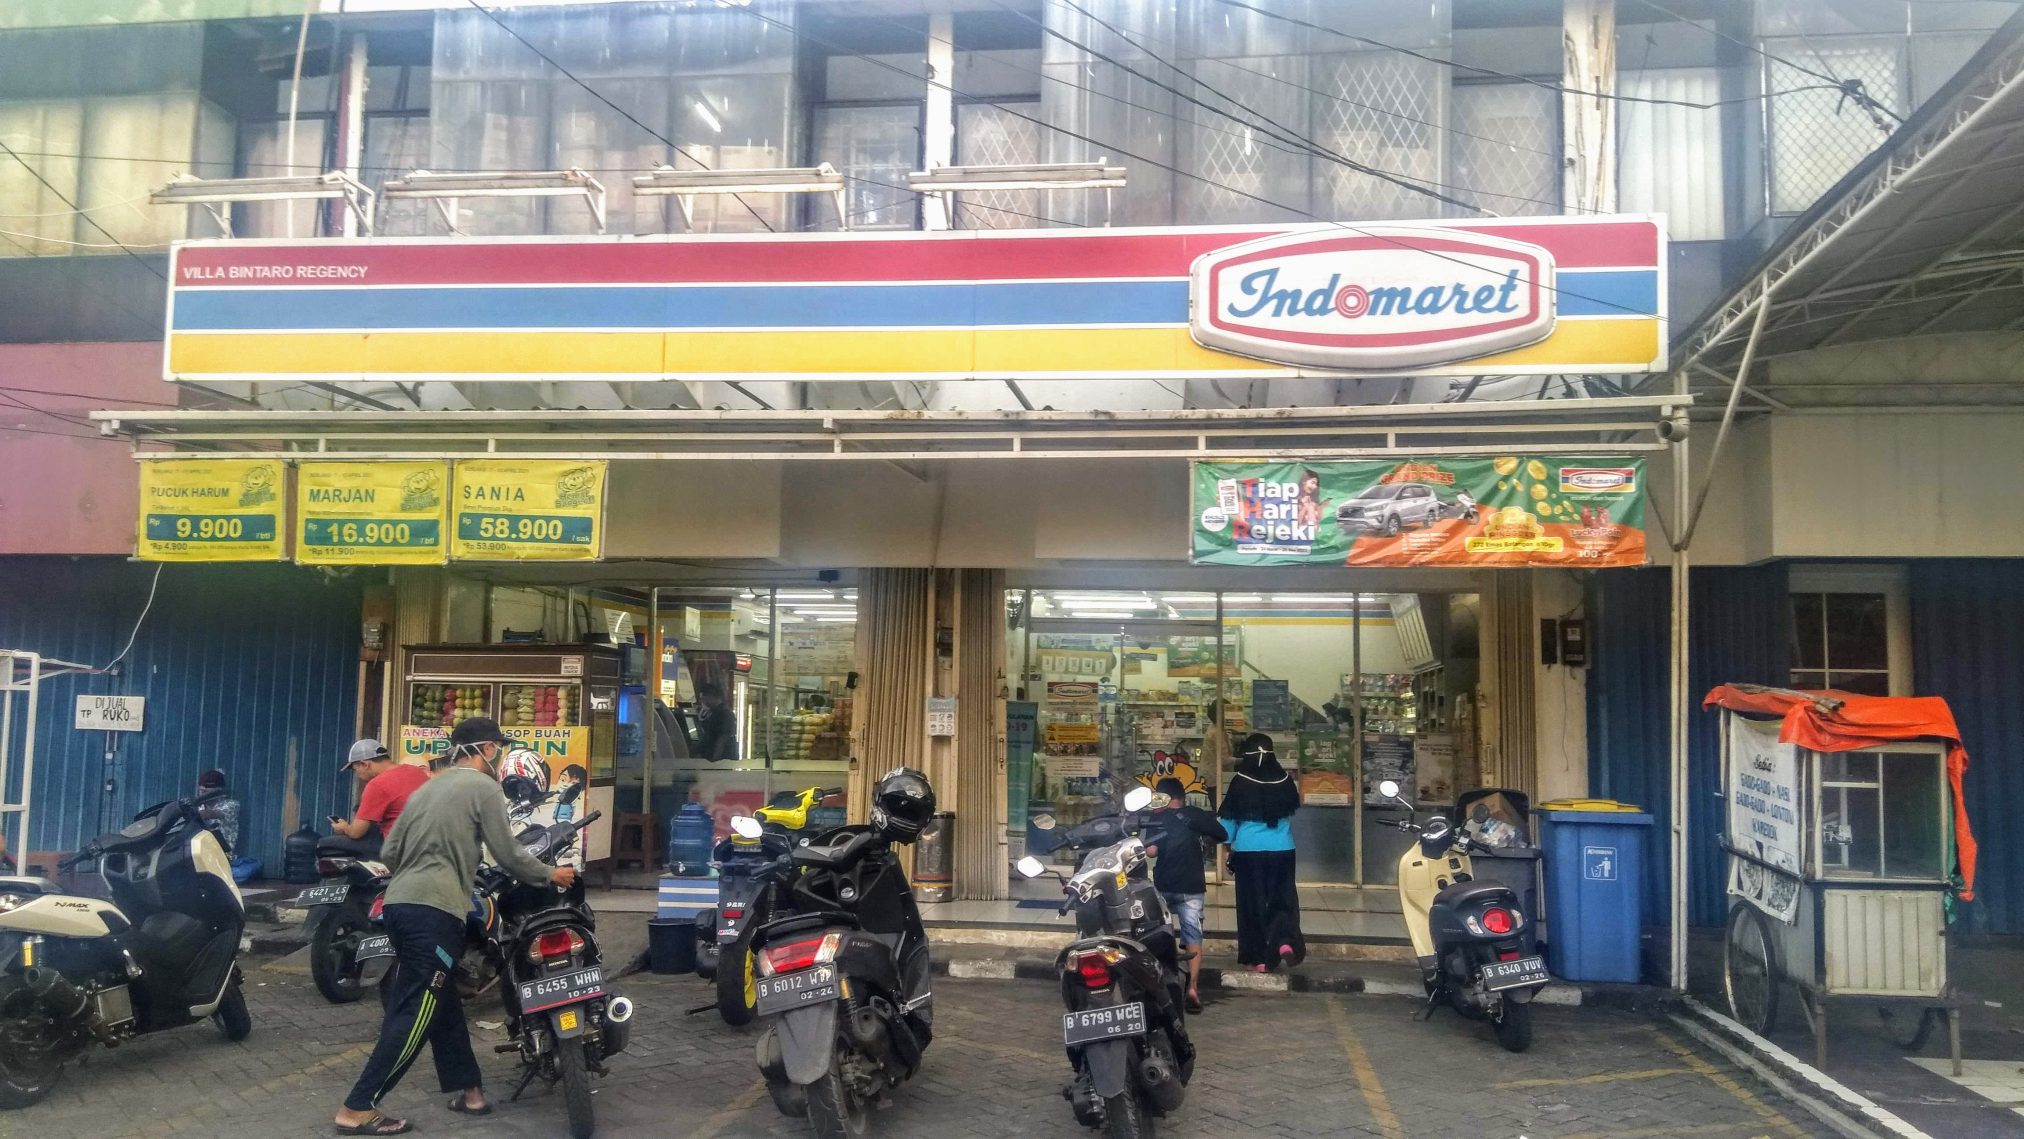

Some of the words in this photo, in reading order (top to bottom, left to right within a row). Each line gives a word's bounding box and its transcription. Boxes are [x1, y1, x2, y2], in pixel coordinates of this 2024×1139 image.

[184, 266, 226, 279] VILLA
[229, 265, 294, 279] BINTARO
[297, 264, 368, 279] REGENCY
[1227, 266, 1520, 319] Indomaret
[151, 486, 189, 498] PUCUK
[191, 487, 230, 498] HARUM
[309, 488, 376, 503] MARJAN
[1241, 477, 1300, 501] Tiap
[1244, 498, 1299, 520] Hari
[148, 518, 160, 526] Rp
[176, 517, 243, 539] 9.900
[307, 522, 318, 531] Rp
[327, 522, 410, 544] 16.900
[462, 517, 472, 525] Rp
[479, 517, 563, 540] 58.900
[1232, 520, 1315, 543] Rejeki
[164, 542, 188, 551] 4.900
[325, 547, 355, 555] 11.900
[476, 542, 507, 551] 53.900
[80, 709, 92, 718] TP
[102, 709, 130, 721] RUKO
[403, 728, 447, 737] ANEKA
[505, 729, 530, 738] SOP
[534, 729, 571, 738] BUAH
[1486, 968, 1494, 977] B
[1497, 964, 1521, 976] 6340
[1523, 960, 1541, 971] VUV
[524, 987, 532, 998] B
[537, 978, 568, 995] 6455
[574, 970, 600, 986] WHN
[760, 984, 768, 997] B
[774, 976, 803, 993] 6012
[1066, 1016, 1074, 1029] B
[1081, 1010, 1112, 1026] 6799
[1115, 1005, 1141, 1021] WCE
